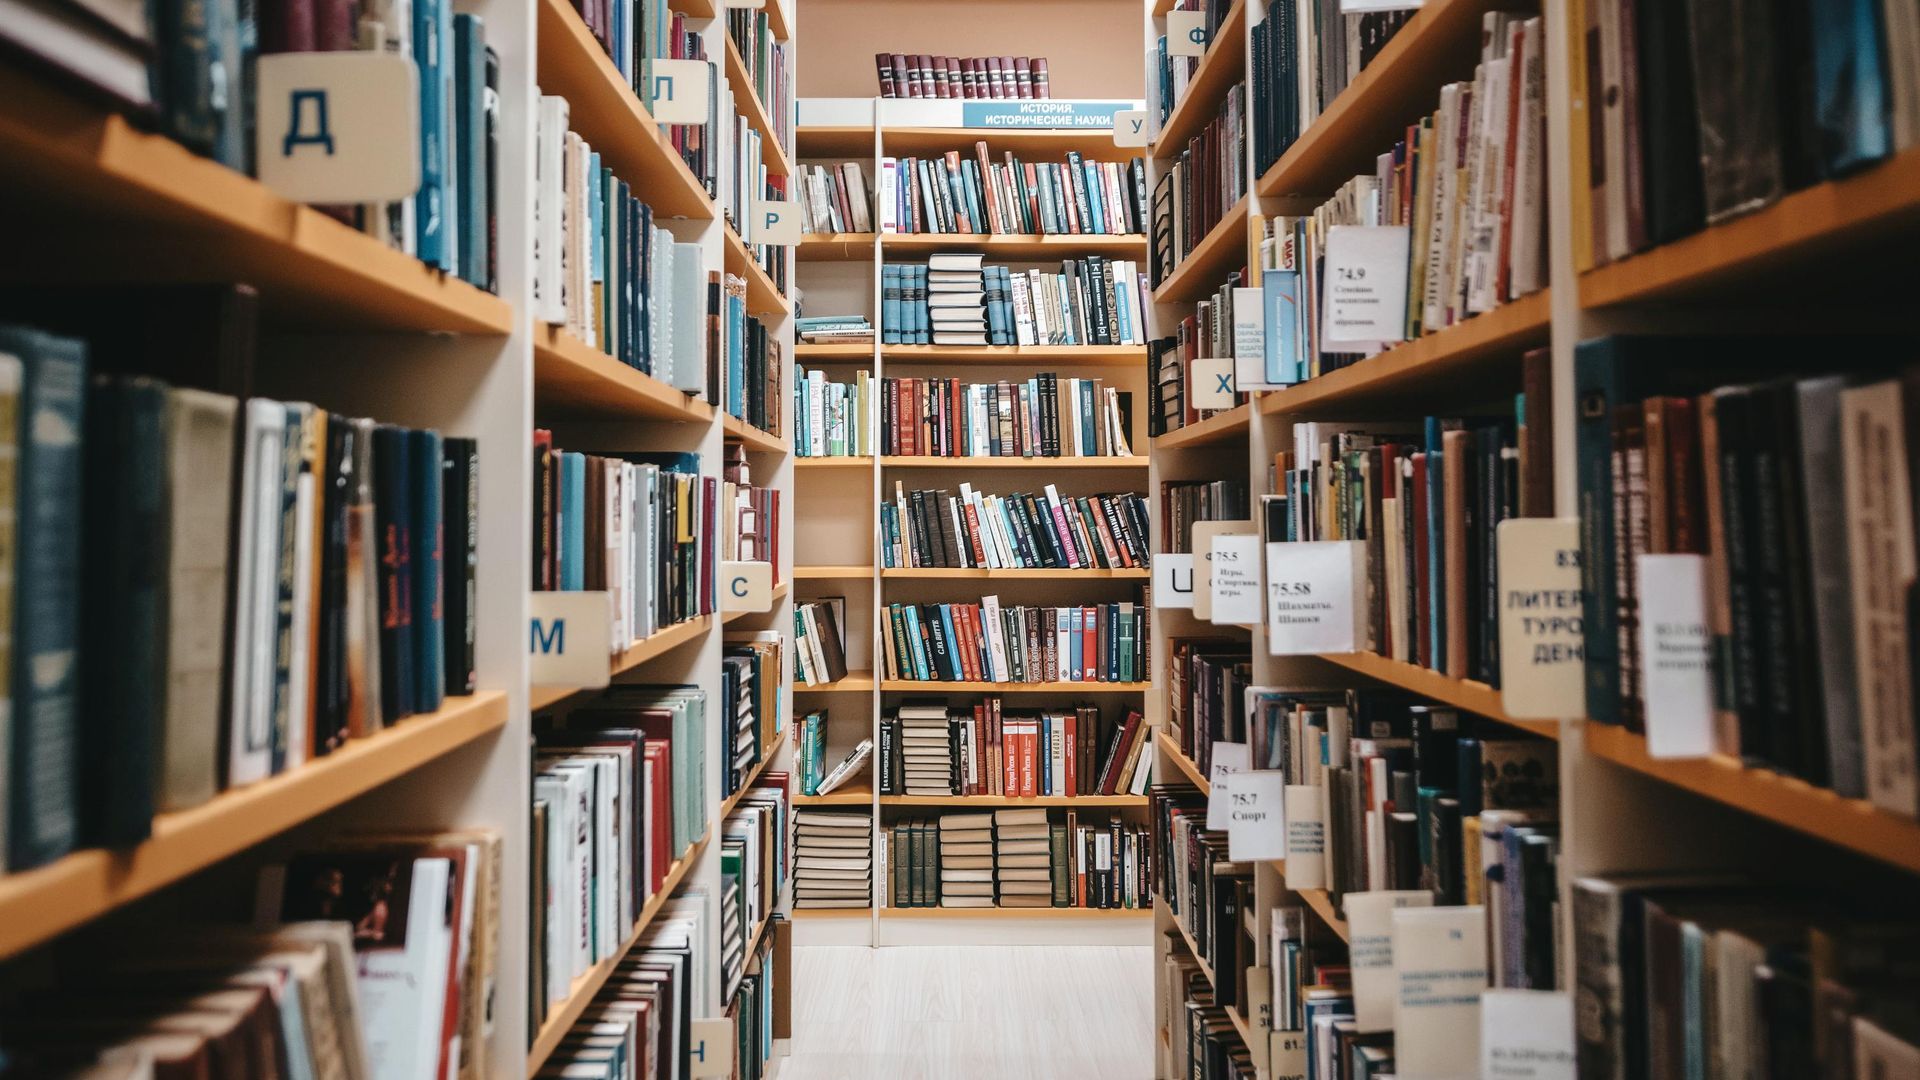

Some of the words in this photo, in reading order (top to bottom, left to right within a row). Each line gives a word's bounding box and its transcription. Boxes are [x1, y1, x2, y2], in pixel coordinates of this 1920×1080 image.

[1189, 26, 1207, 45] Ф
[653, 76, 674, 102] Л
[1019, 103, 1074, 114] ИСТОРИЯ.
[282, 88, 335, 157] Д
[984, 115, 1072, 126] ИСТОРИЧЕСКИЕ
[1074, 115, 1114, 126] НАУКИ.
[1130, 118, 1143, 134] У
[765, 212, 780, 230] Р
[1337, 266, 1366, 281] 74.9
[1215, 374, 1233, 394] Х
[968, 509, 977, 527] ВЕКА
[1056, 511, 1067, 535] ВРЕМЯ
[973, 528, 983, 560] СРЕДНИЕ
[1063, 535, 1075, 561] НОВОЕ
[1216, 551, 1238, 561] 75.5
[731, 576, 749, 598] С
[1270, 583, 1311, 596] 75.58
[530, 617, 564, 656] М
[932, 619, 942, 641] ВИТТЕ
[1052, 729, 1060, 759] ИСТОРИЯ
[1006, 755, 1015, 772] России
[1022, 755, 1031, 772] России
[1007, 772, 1018, 791] История
[1022, 772, 1033, 791] История
[1232, 793, 1257, 805] 75.7
[1232, 811, 1267, 823] Спорт
